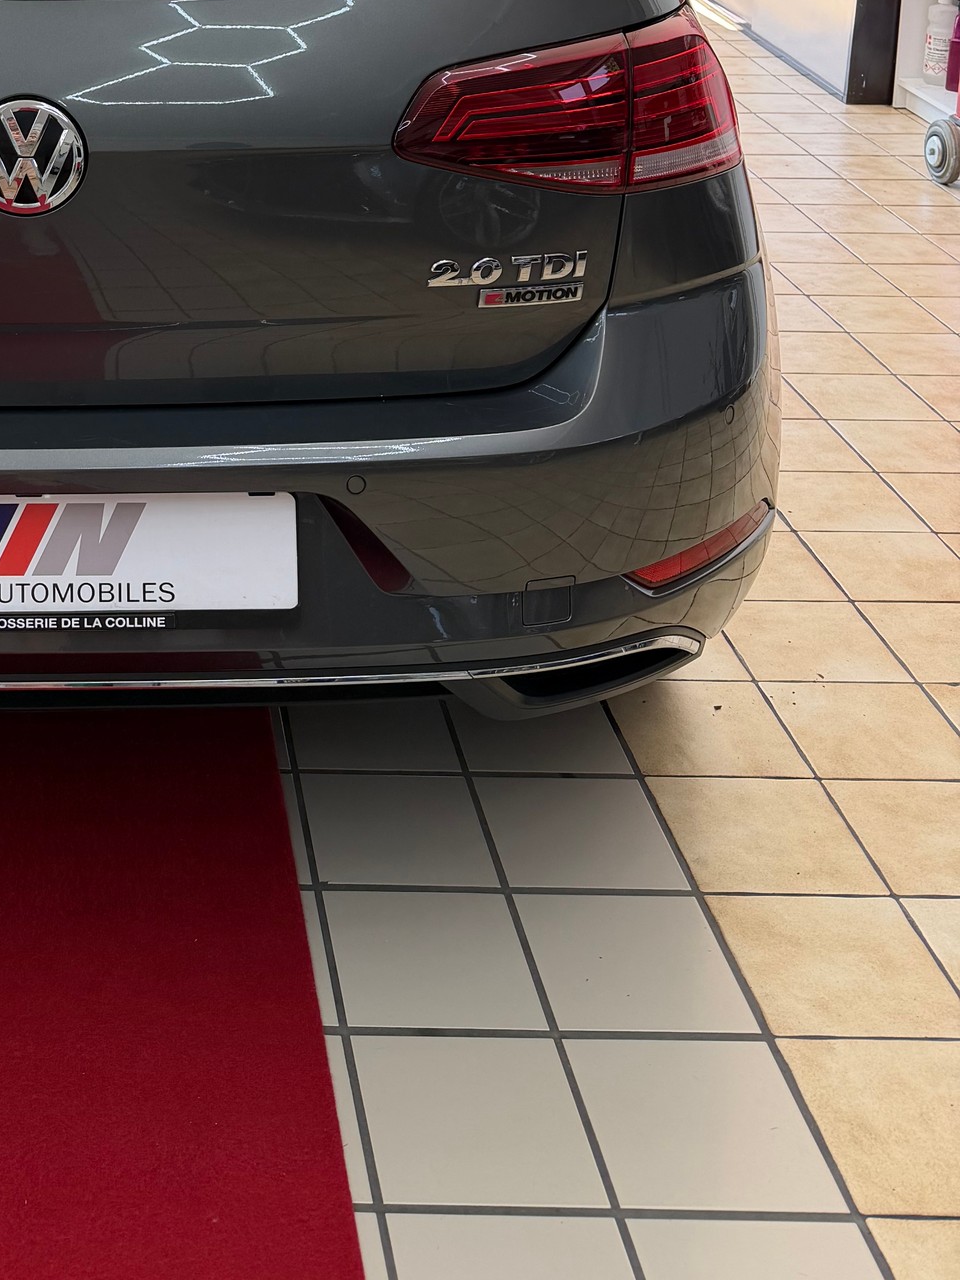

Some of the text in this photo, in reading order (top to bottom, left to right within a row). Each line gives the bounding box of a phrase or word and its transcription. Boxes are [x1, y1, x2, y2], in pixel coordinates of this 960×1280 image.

[427, 250, 588, 288] 2.0 TDI
[61, 617, 81, 629] DE
[84, 617, 103, 628] LA
[105, 617, 166, 628] COLLINE
